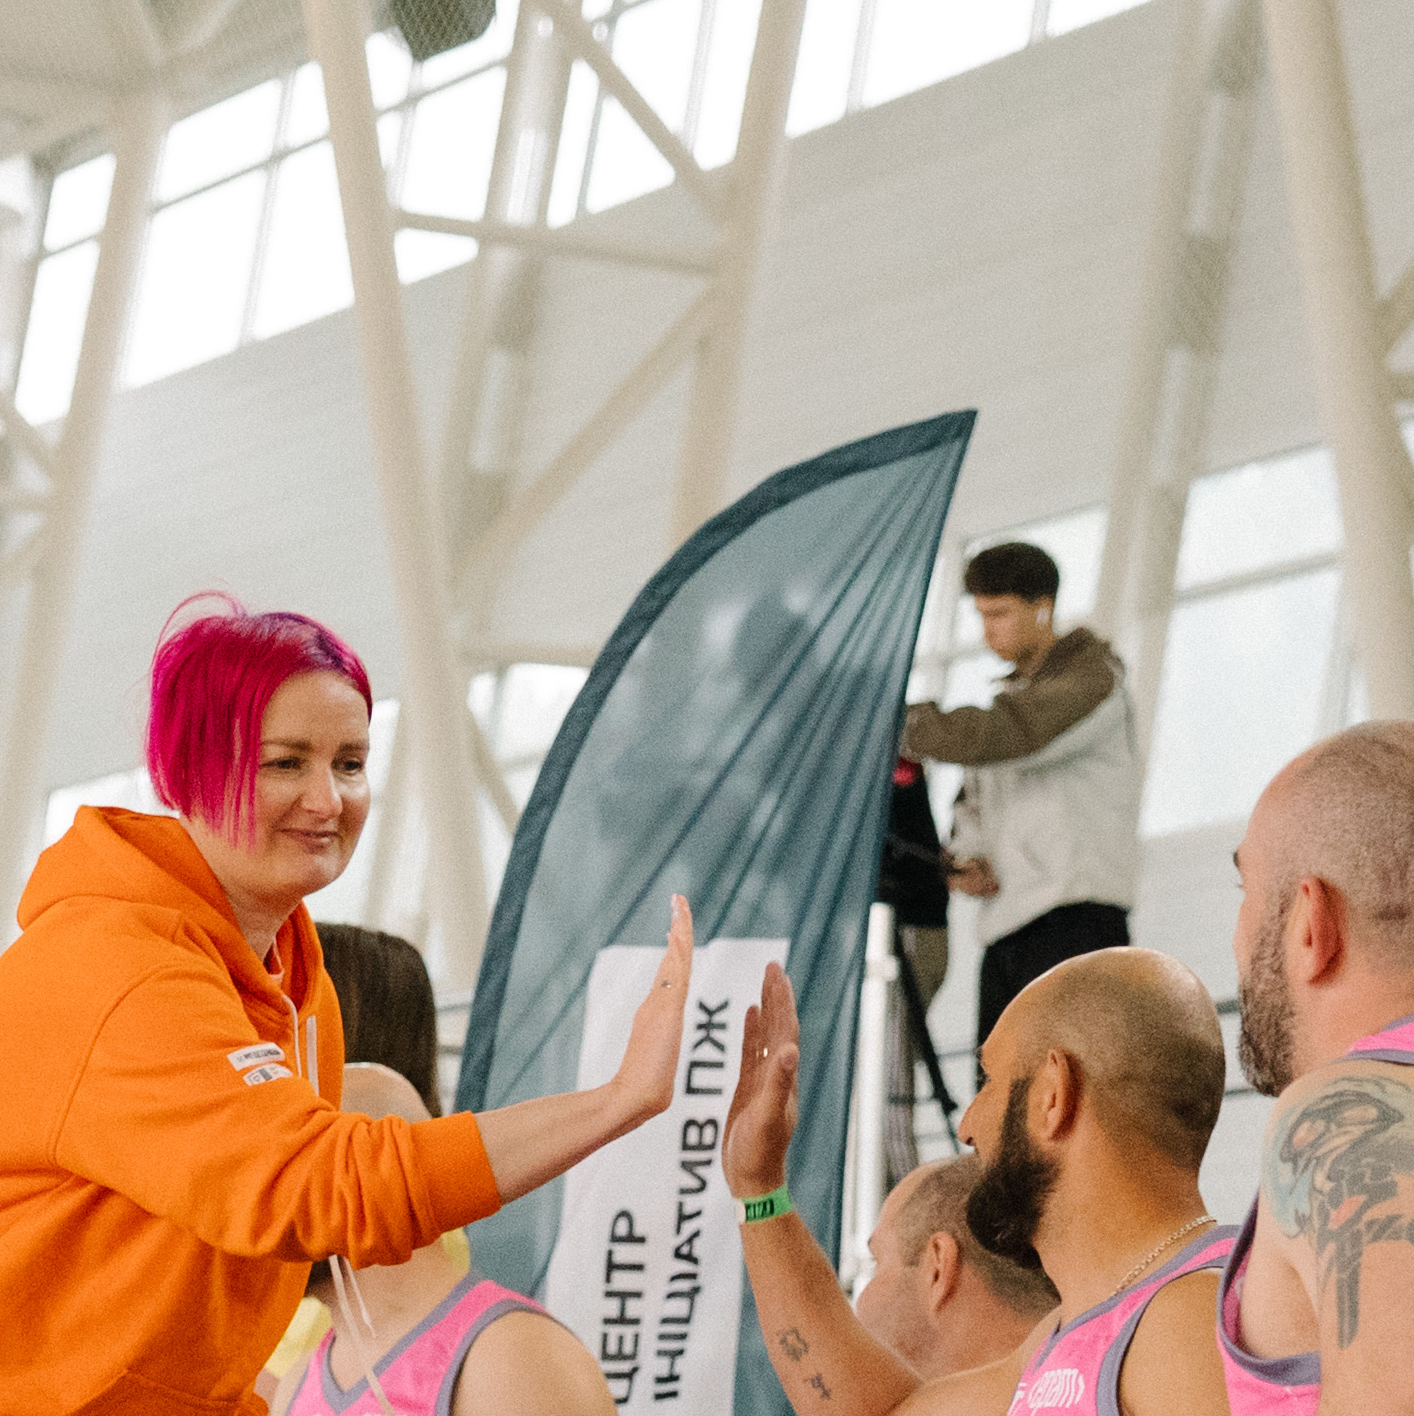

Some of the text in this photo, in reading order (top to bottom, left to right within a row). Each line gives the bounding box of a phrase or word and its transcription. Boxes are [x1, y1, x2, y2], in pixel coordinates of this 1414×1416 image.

[599, 1209, 647, 1404] ЦЕНТР
[653, 998, 730, 1402] ІНІЦІАТИВ ПЖ
